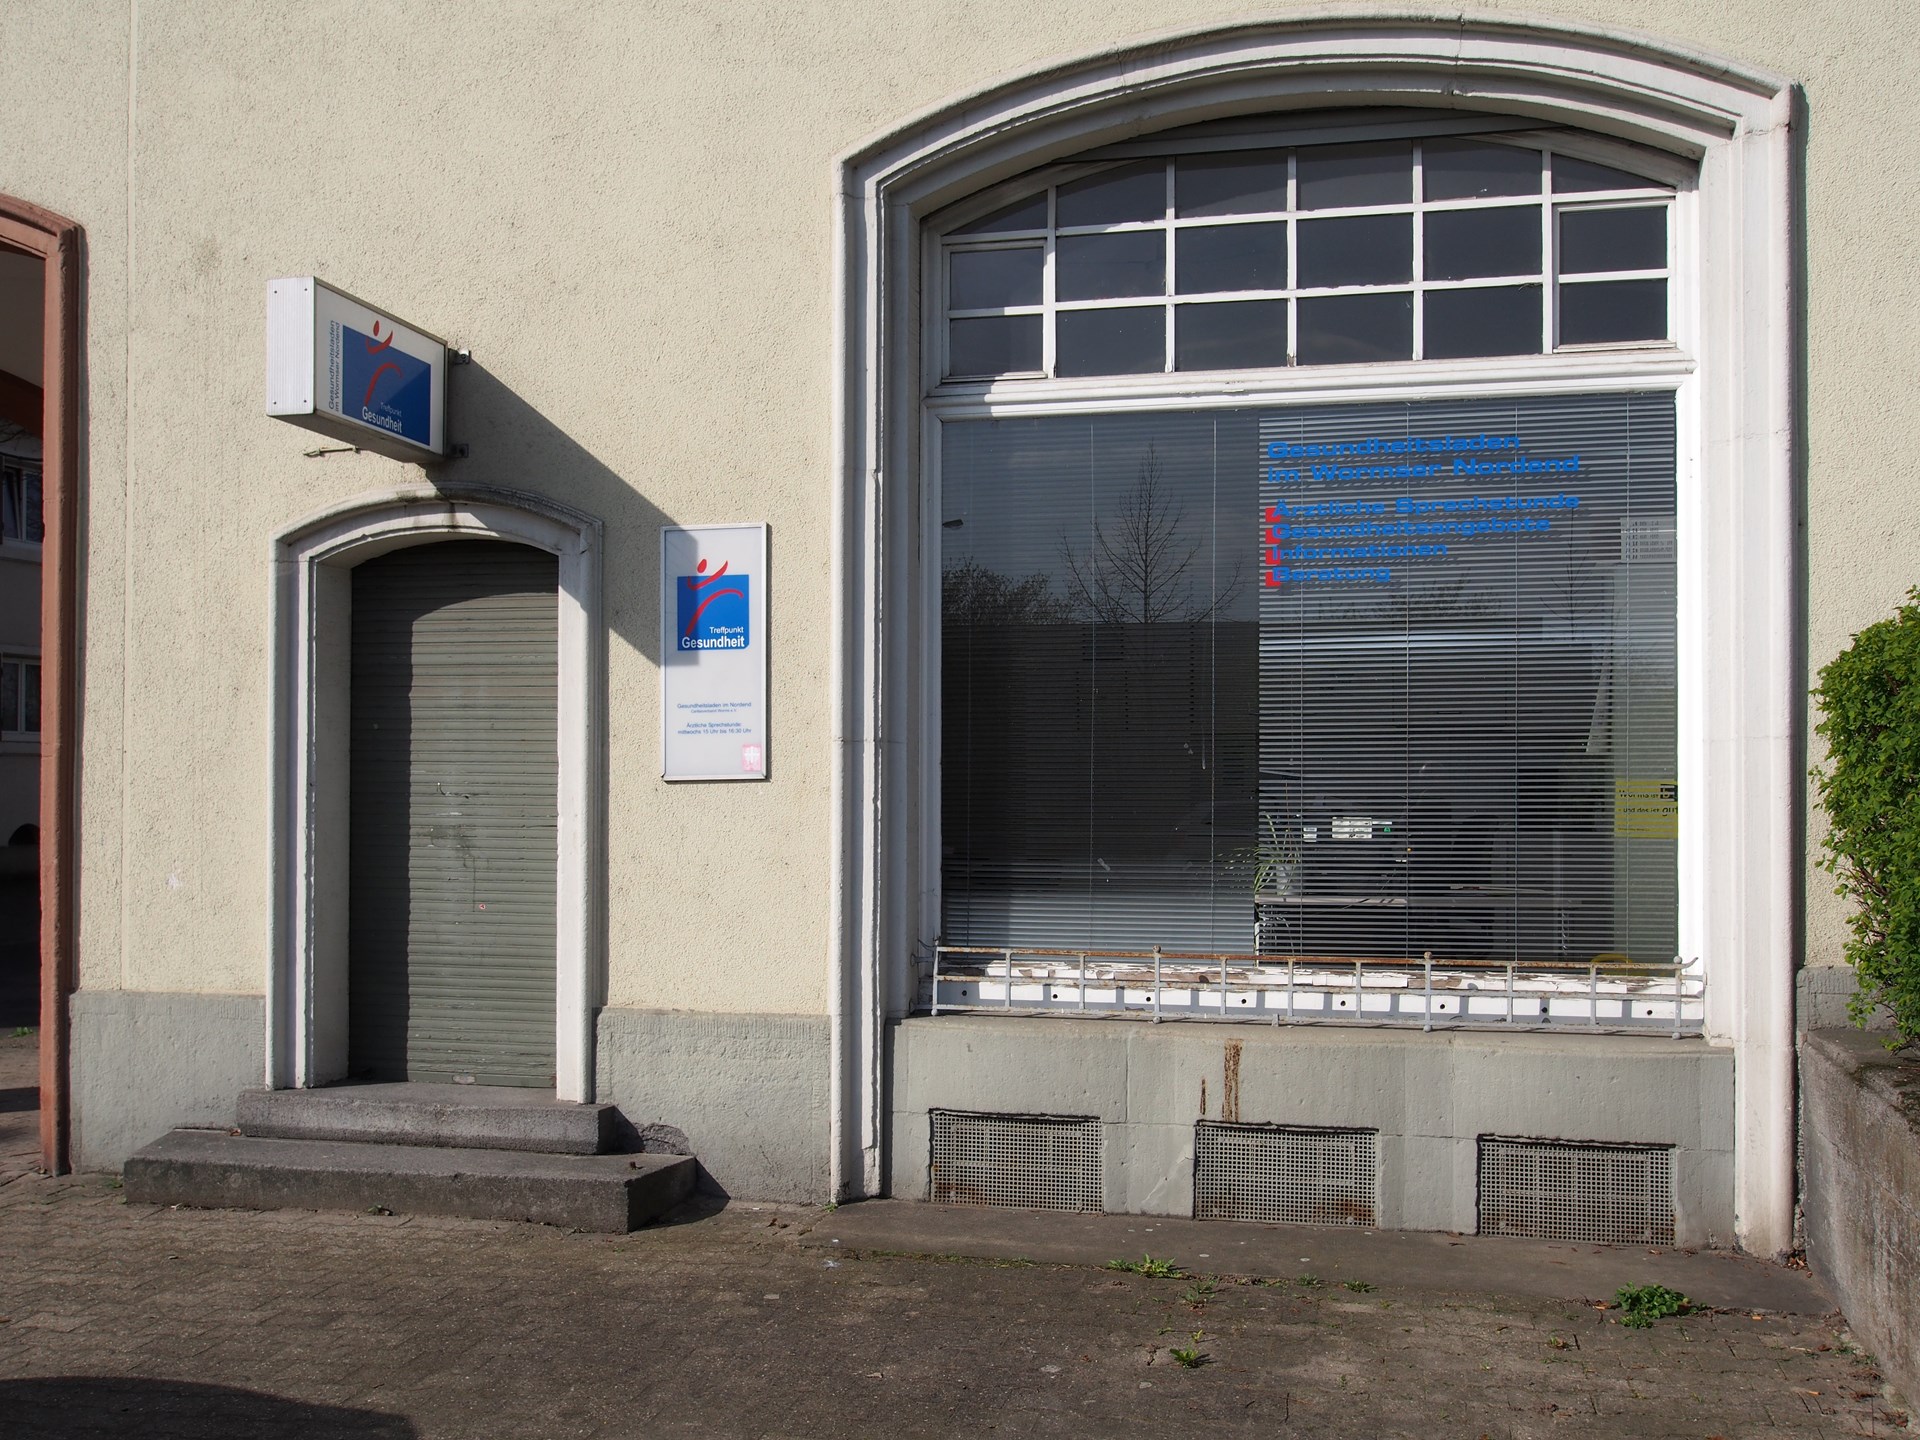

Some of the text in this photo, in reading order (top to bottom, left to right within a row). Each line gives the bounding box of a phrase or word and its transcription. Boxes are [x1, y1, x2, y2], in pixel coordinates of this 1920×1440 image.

[380, 402, 402, 417] Treffpunkt
[362, 406, 402, 433] Gesundheit
[1268, 434, 1520, 459] Gesundheitsladen
[1268, 455, 1579, 482] im Wormser Nordend
[1272, 493, 1579, 518] Ärztliche Sprechstunde
[1272, 518, 1550, 539] Gesundheitsangebote
[1272, 543, 1447, 560] Informationen
[1272, 565, 1390, 582] Beratung
[709, 626, 744, 634] Treffpunkt
[682, 635, 745, 648] Gesundheit
